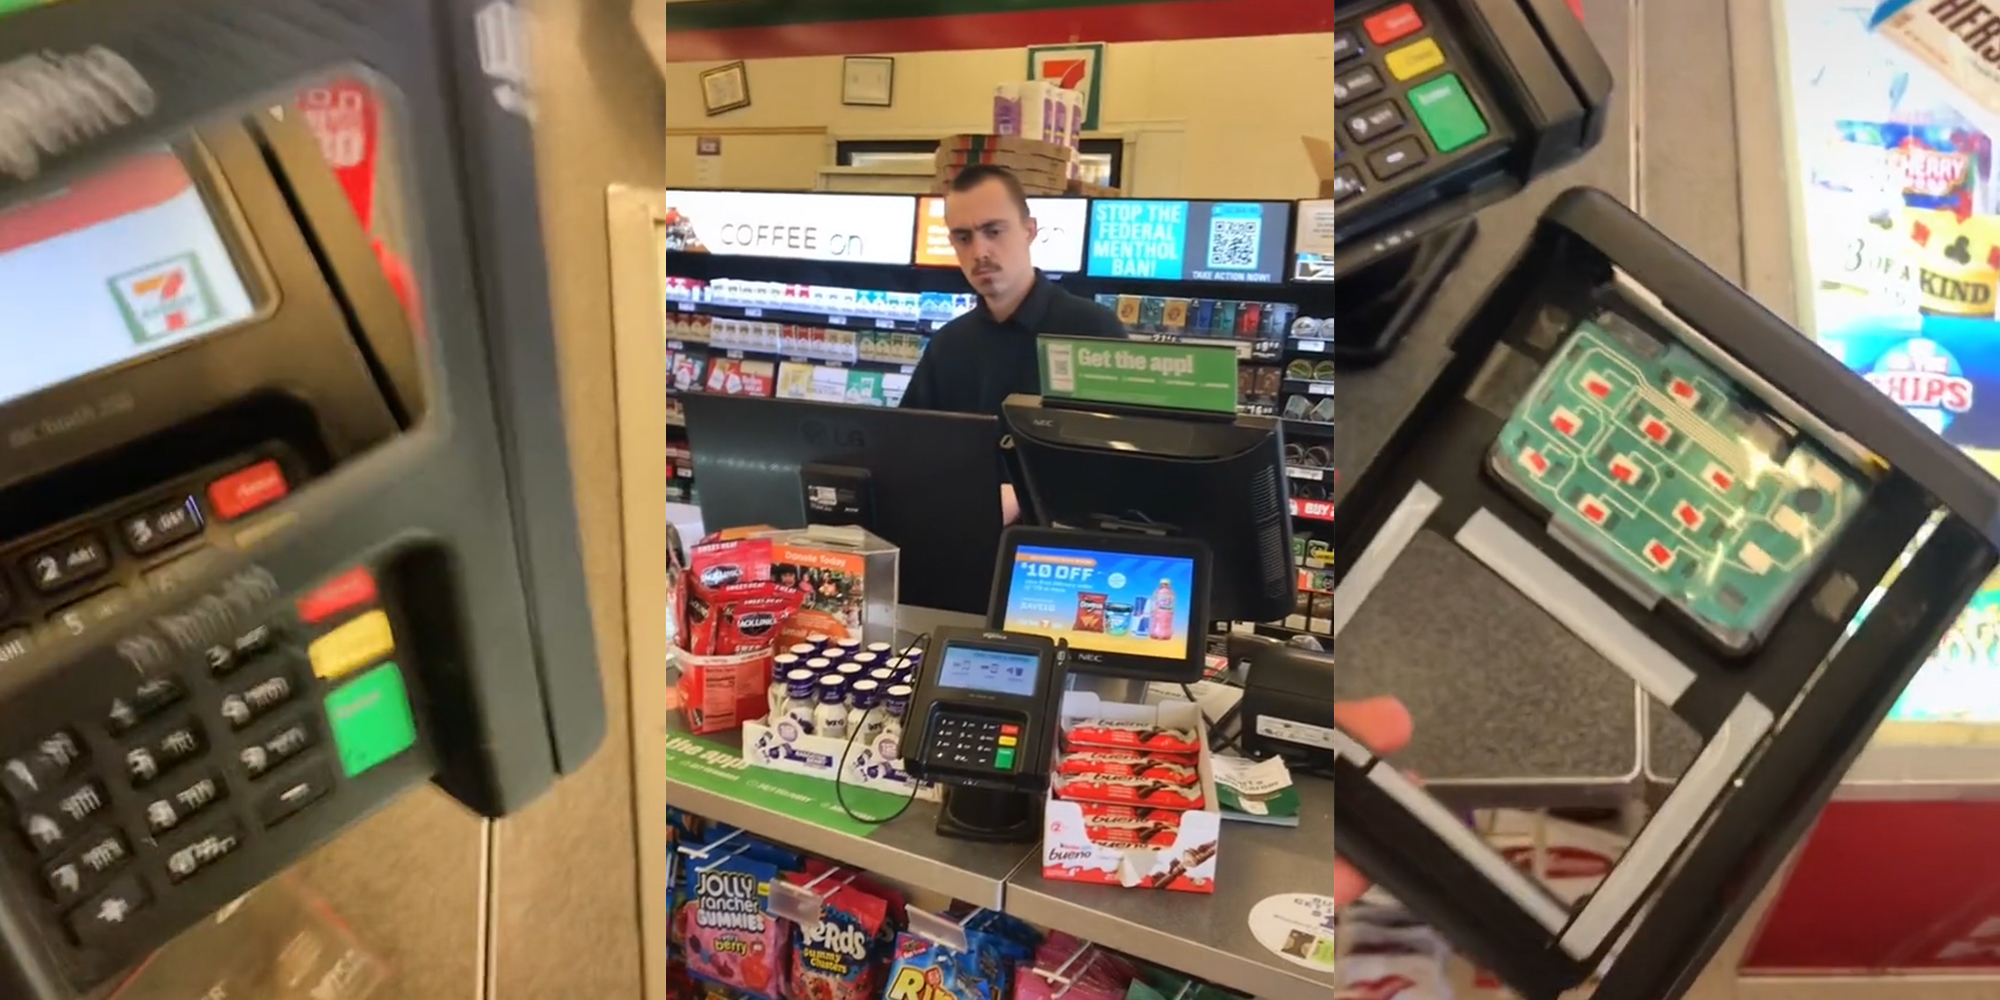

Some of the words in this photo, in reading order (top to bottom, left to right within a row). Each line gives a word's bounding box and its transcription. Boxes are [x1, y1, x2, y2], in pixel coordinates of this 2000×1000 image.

[1096, 204, 1147, 222] STOP
[1150, 204, 1181, 223] THE
[721, 223, 817, 249] COFFEE
[1100, 221, 1174, 241] FEDERAL
[1094, 240, 1177, 260] MENTHOL
[1111, 258, 1157, 277] BAN!
[1213, 271, 1247, 281] ACTION
[1247, 272, 1271, 282] NOW!
[1919, 267, 1991, 305] KIND
[1078, 348, 1111, 368] Get
[1115, 351, 1147, 370] the
[1150, 354, 1194, 376] app!
[1880, 376, 1968, 409] HIPS
[785, 551, 818, 562] Donate
[820, 555, 846, 567] Today
[1055, 565, 1094, 581] OFF
[1078, 653, 1102, 662] NEC
[1092, 815, 1149, 823] bueno
[1049, 848, 1092, 860] bueno
[697, 873, 754, 898] JOLLY
[700, 897, 759, 913] rancher
[697, 910, 765, 931] GUMMIES
[714, 939, 747, 955] berry
